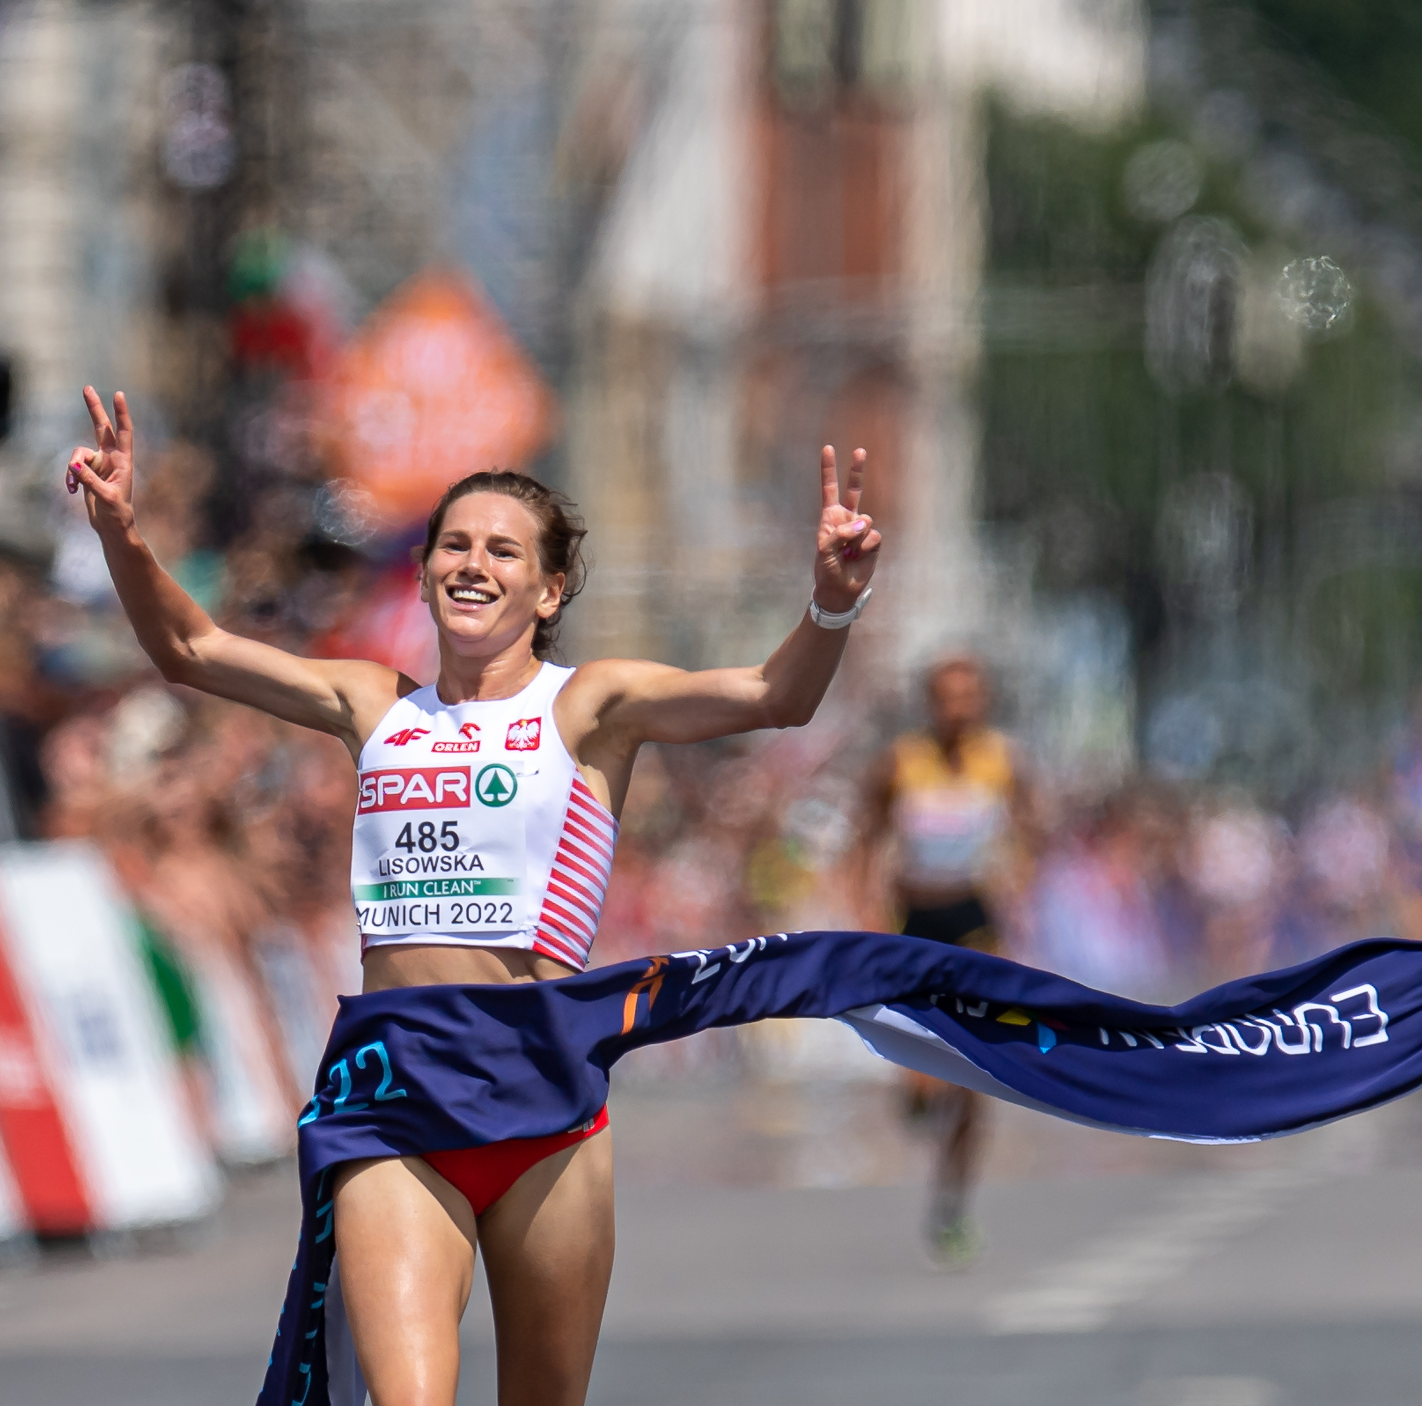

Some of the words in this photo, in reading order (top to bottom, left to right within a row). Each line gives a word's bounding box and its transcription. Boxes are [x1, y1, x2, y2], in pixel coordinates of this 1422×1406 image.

[434, 742, 479, 752] ORLEN
[361, 771, 468, 809] SPAR
[395, 820, 460, 854] 485
[378, 854, 485, 877] LISOWSKA
[390, 882, 419, 897] RUN
[355, 903, 440, 927] MUNICH
[450, 902, 513, 925] 2022
